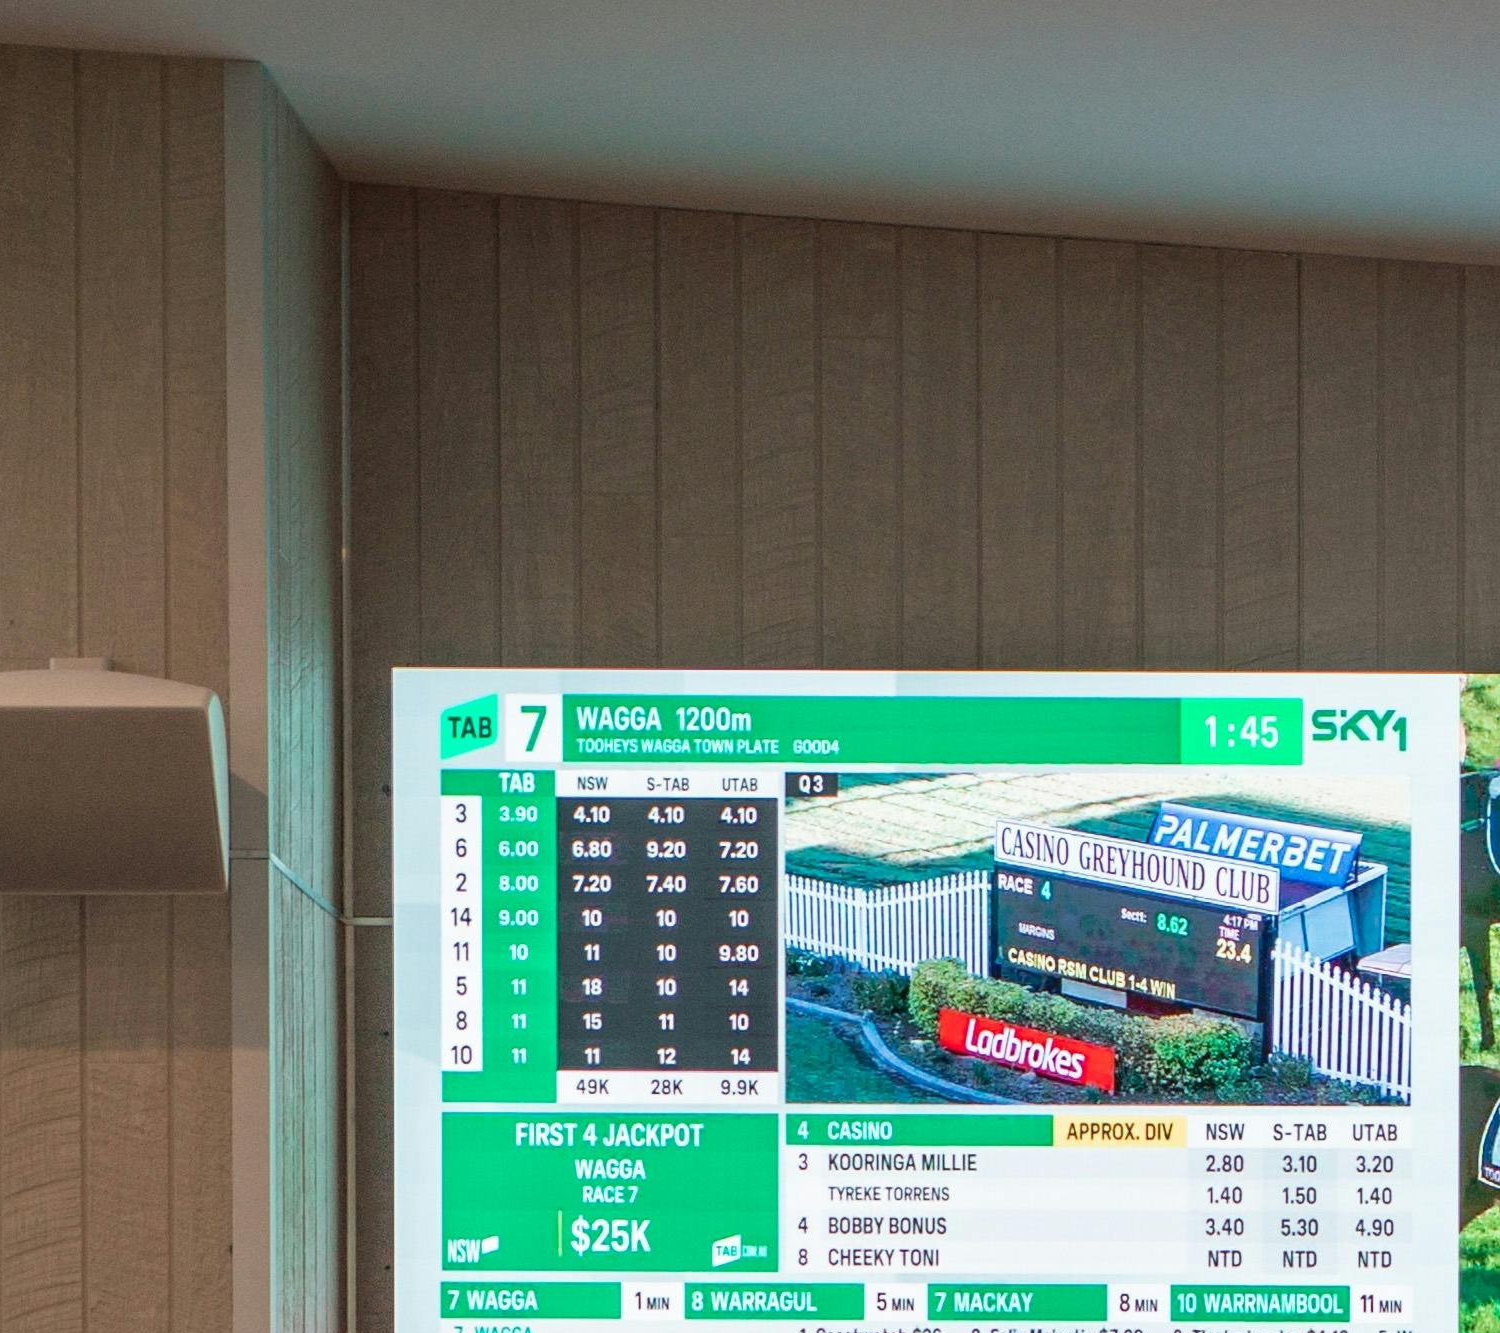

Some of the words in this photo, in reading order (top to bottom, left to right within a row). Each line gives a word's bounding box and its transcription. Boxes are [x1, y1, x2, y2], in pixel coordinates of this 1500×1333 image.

[448, 716, 493, 738] TAB
[520, 705, 547, 752] 7
[577, 707, 661, 731] WAGGA
[677, 707, 752, 732] 1200m
[1205, 715, 1278, 748] 1:45
[577, 738, 638, 753] TOOHEYS
[641, 738, 690, 754] WAGGA
[694, 738, 733, 754] TOWN
[737, 738, 779, 754] PLATE
[500, 773, 535, 792] TAB
[577, 776, 608, 791] NSW
[647, 777, 690, 792] S-TAB
[722, 777, 757, 792] UTAB
[455, 805, 467, 823] 3
[499, 807, 538, 823] 3.90
[573, 807, 610, 824] 4.10
[647, 807, 685, 824] 4.10
[721, 807, 757, 824] 4.10
[1154, 816, 1352, 874] PALMERBET
[1001, 827, 1069, 865] CASINO
[1079, 842, 1205, 891] GREYHOUND
[1216, 867, 1270, 904] CLUB
[998, 874, 1032, 894] RACE
[1041, 881, 1051, 899] 4
[1215, 938, 1252, 963] 23.4
[965, 1018, 1084, 1081] Ladbrokes
[515, 1124, 577, 1145] FIRST
[583, 1125, 597, 1145] 4
[603, 1125, 703, 1147] JACKPOT
[828, 1121, 892, 1140] CASINO
[1067, 1123, 1140, 1141] APPROX.
[1146, 1124, 1173, 1141] DIV
[829, 1153, 918, 1172] KOORINGA
[922, 1155, 976, 1171] MILLIE
[1206, 1156, 1244, 1173] 2.80
[1282, 1155, 1317, 1173] 3.10
[1356, 1156, 1394, 1173] 3.20
[571, 1217, 650, 1254] $25K
[449, 1290, 459, 1310] 7
[467, 1290, 538, 1311] WAGGA
[692, 1292, 704, 1312] 8
[711, 1291, 817, 1313] WARRAGUL
